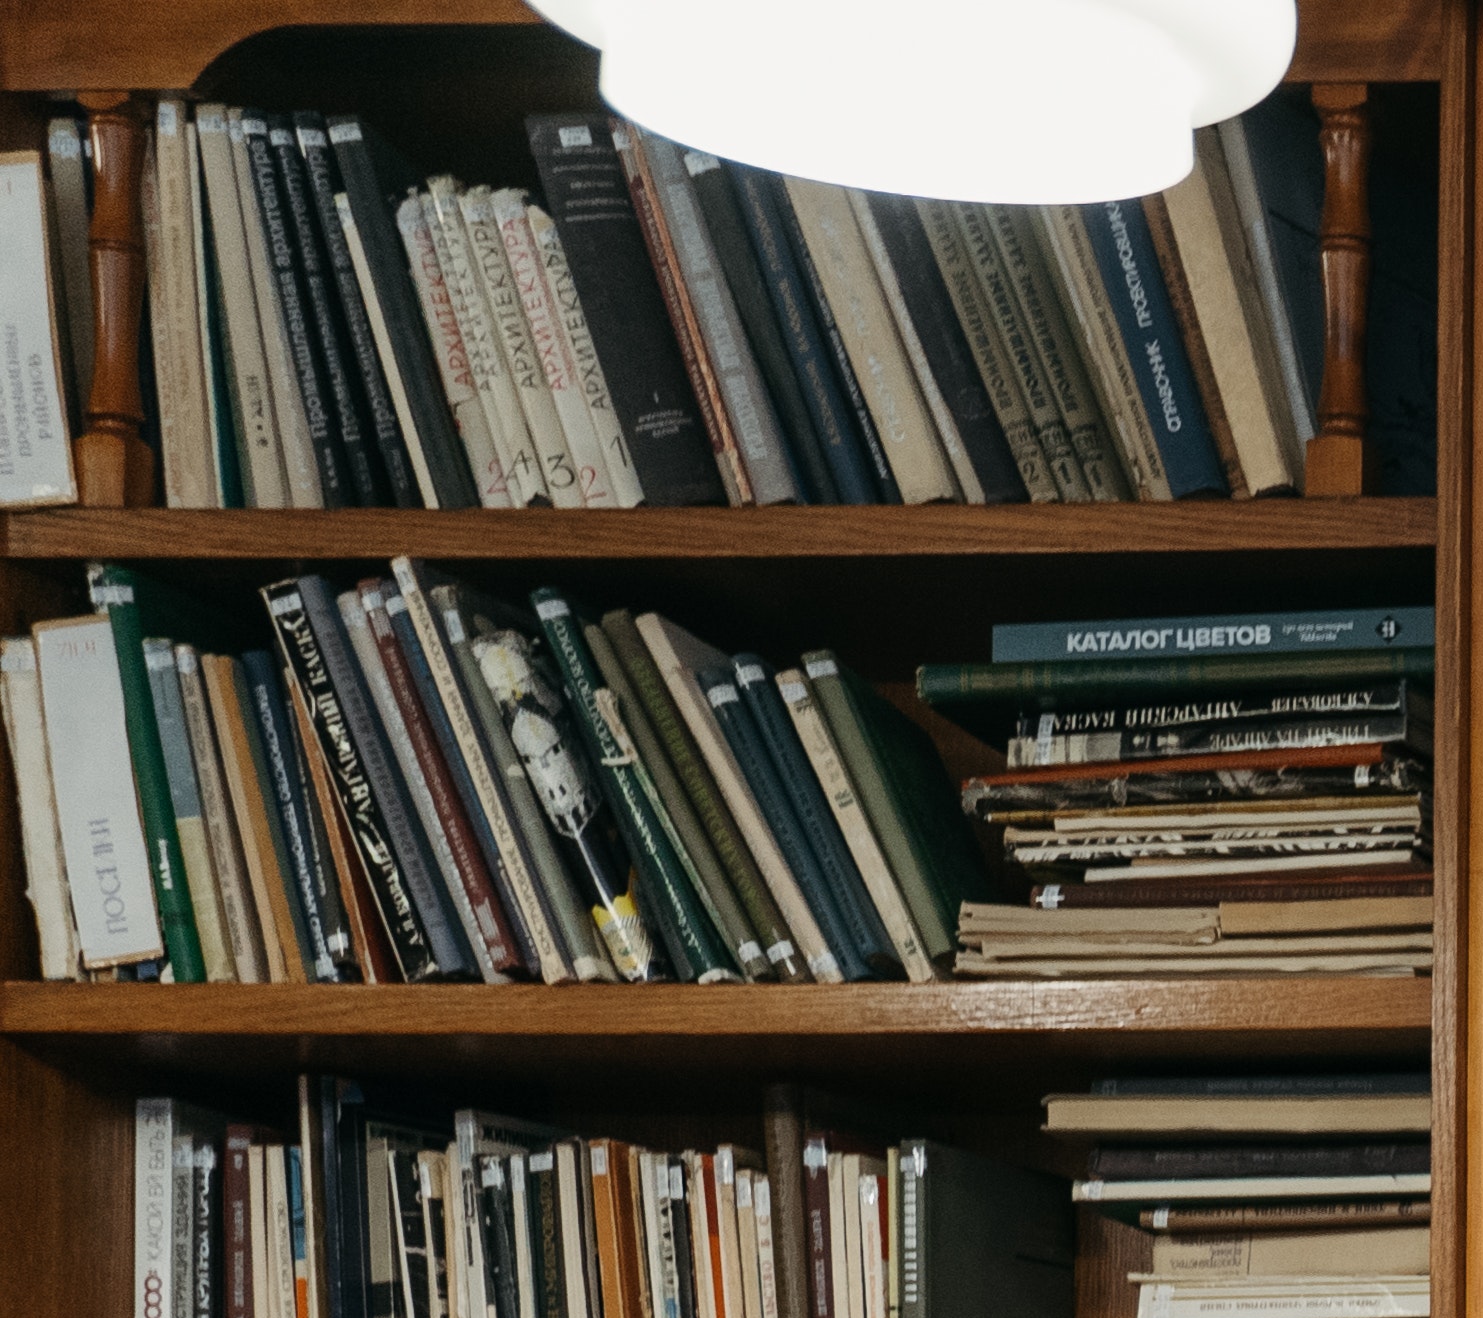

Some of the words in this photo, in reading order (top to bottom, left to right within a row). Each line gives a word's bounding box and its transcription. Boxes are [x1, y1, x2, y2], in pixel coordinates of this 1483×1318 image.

[247, 139, 293, 266] архитектура
[494, 218, 571, 394] АРХИТЕКТУРА
[537, 239, 613, 411] АРХИТЕКТУРА
[276, 269, 330, 436] Промышленная
[1144, 337, 1183, 433] СПРАВОЧНИК
[286, 612, 329, 687] КАСКА
[1066, 629, 1174, 655] КАТАЛОГ
[1176, 625, 1271, 653] ЦВЕТОВ
[1051, 710, 1115, 732] КАСКА
[1125, 700, 1243, 728] АНГАРСКИЙ
[145, 1201, 163, 1261] КАКОЙ
[175, 1174, 189, 1238] ЗДАНИЙ
